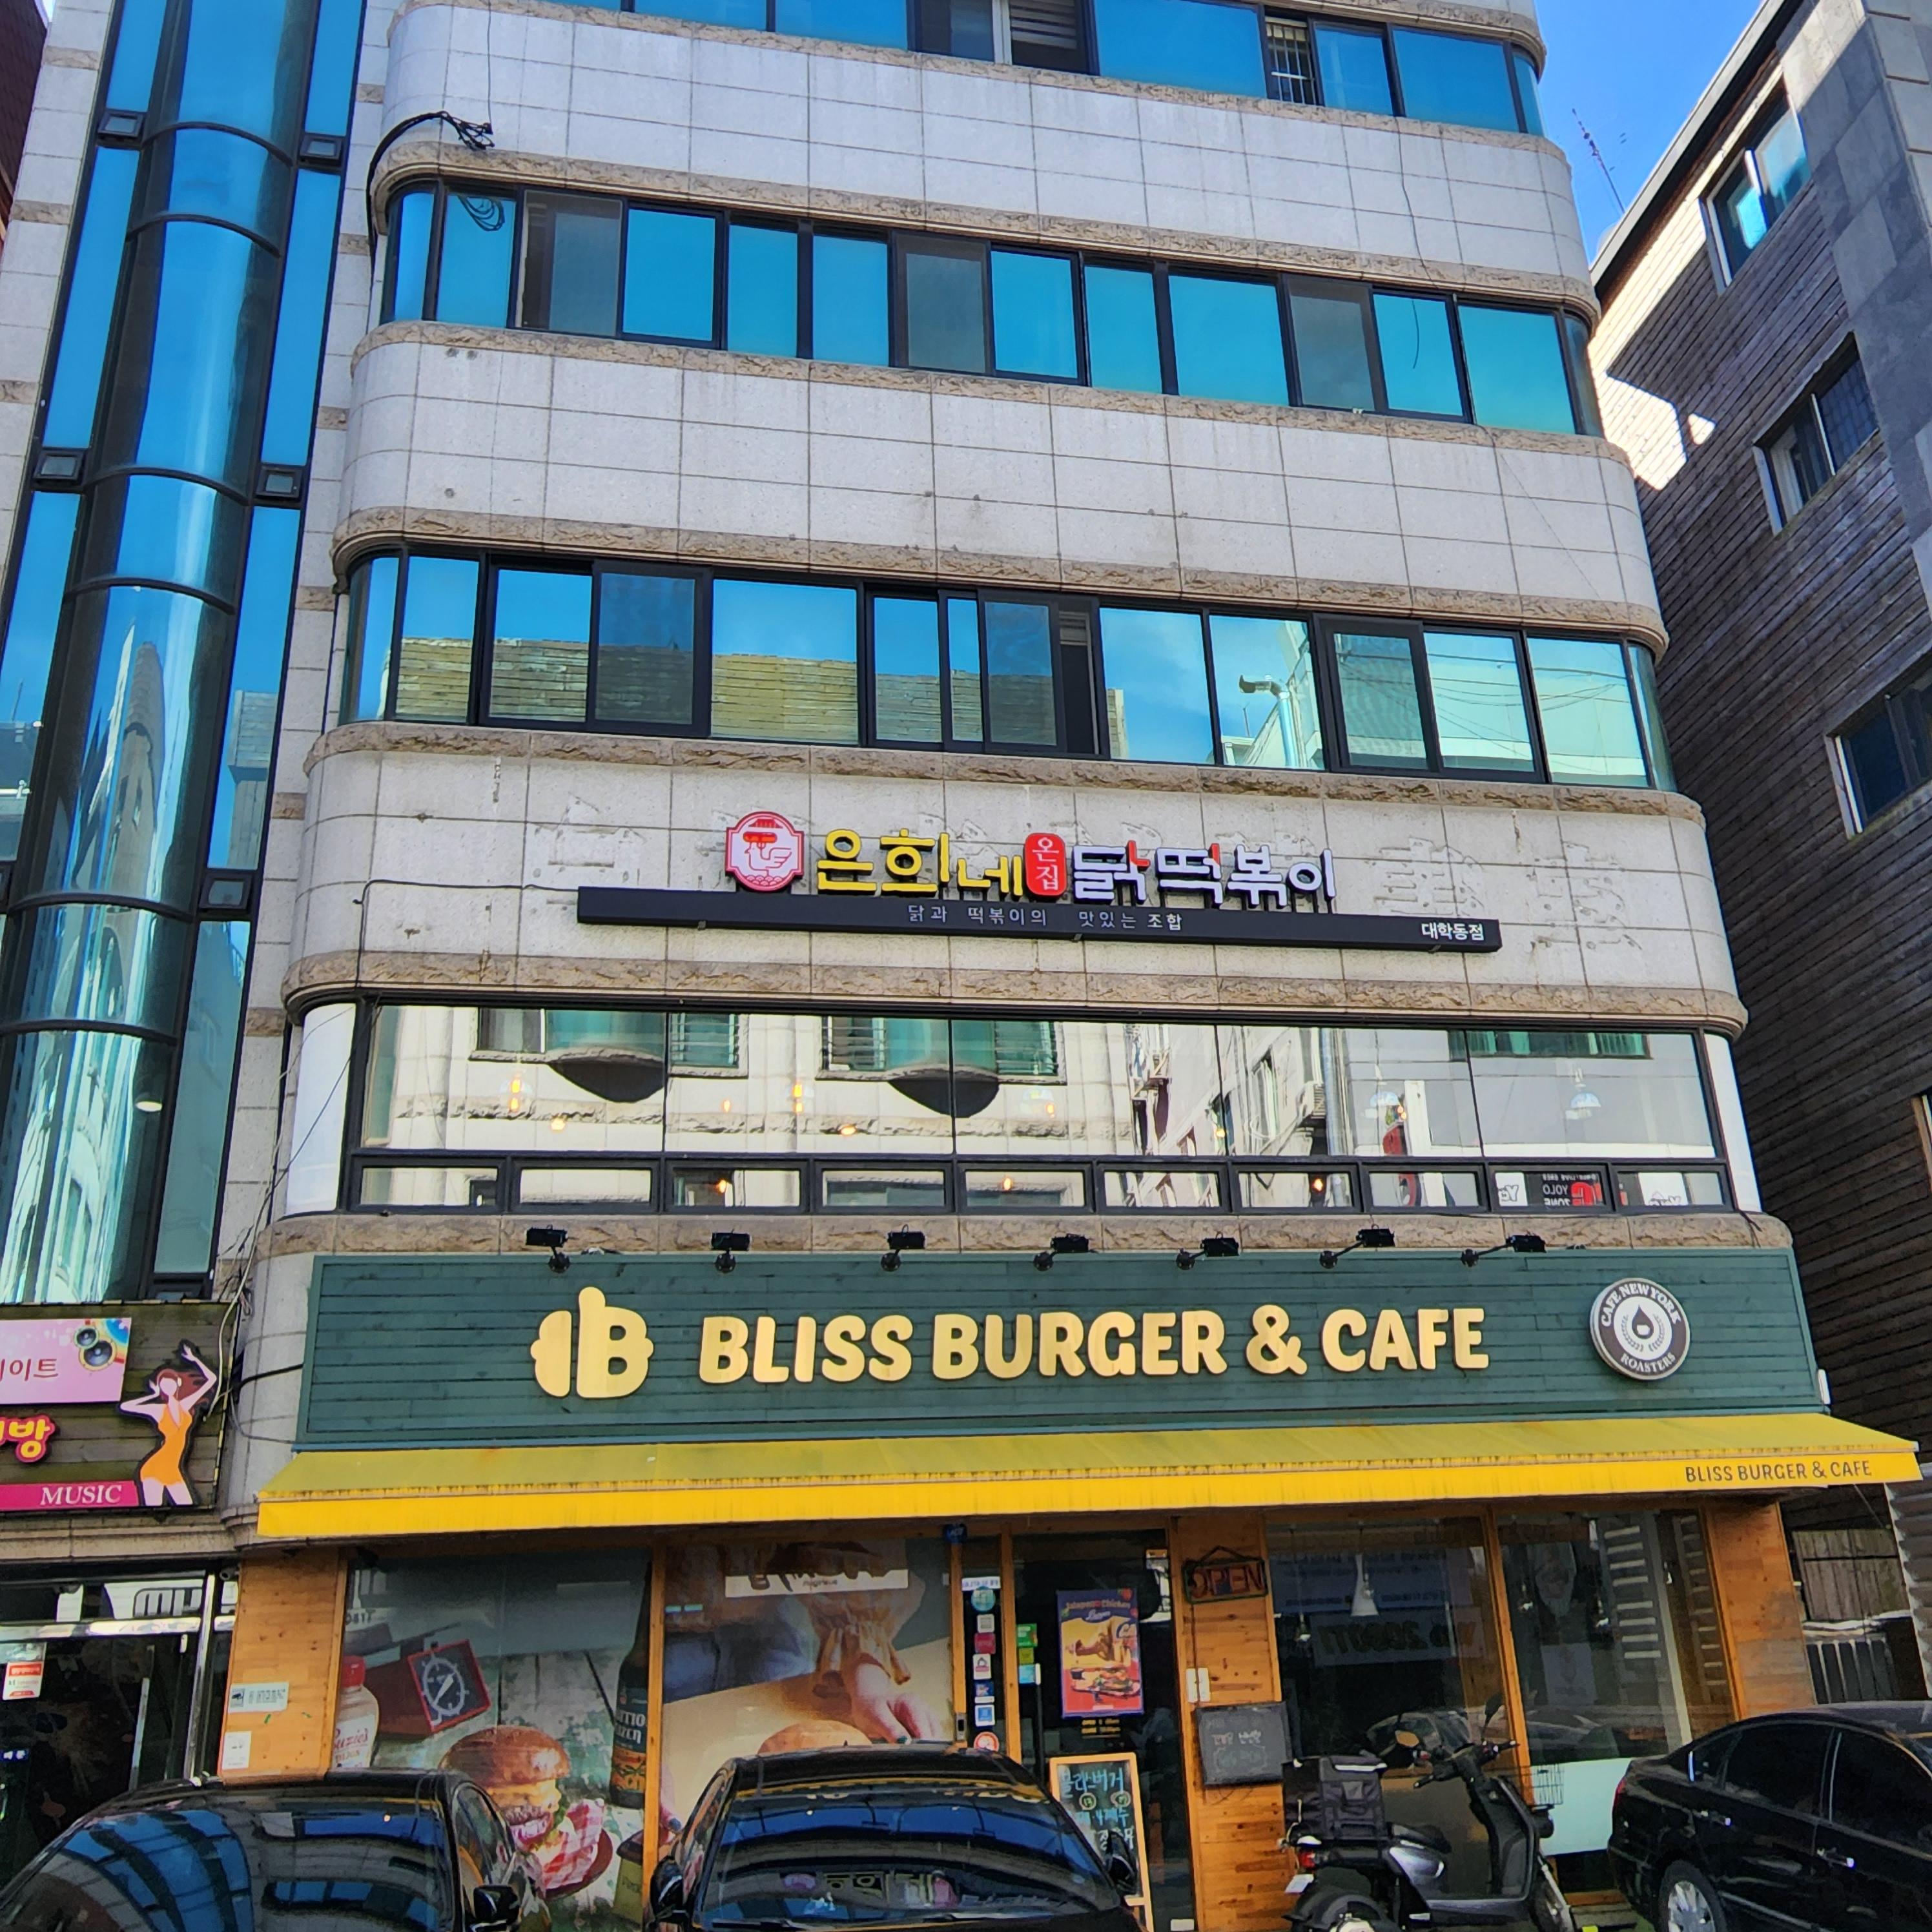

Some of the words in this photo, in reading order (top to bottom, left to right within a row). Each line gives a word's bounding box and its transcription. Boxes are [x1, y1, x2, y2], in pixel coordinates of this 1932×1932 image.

[817, 829, 1022, 896] 은희네
[1073, 840, 1335, 909] 닭떡볶이
[908, 905, 947, 923] 닭과
[968, 907, 1047, 925] 떡볶이의
[1078, 911, 1136, 929] 맛있는
[1147, 913, 1182, 930] 조합
[1421, 922, 1485, 941] 대학동점
[1601, 1290, 1622, 1327] CAFE
[1619, 1283, 1650, 1296] NEW
[1649, 1288, 1681, 1324] YORK
[699, 1315, 914, 1384] BLISS
[932, 1310, 1228, 1381] BURGER
[1246, 1304, 1308, 1375] &
[1322, 1308, 1490, 1372] CAFE
[0, 1358, 59, 1381] 이트
[1621, 1351, 1676, 1373] ROASTERS
[0, 1417, 51, 1459] 방
[1685, 1465, 1733, 1483] BLISS
[1738, 1463, 1807, 1481] BURGER
[1812, 1461, 1827, 1478] &
[1831, 1460, 1872, 1477] CAFE
[40, 1485, 121, 1506] MUSIC
[1191, 1562, 1266, 1598] OPEN
